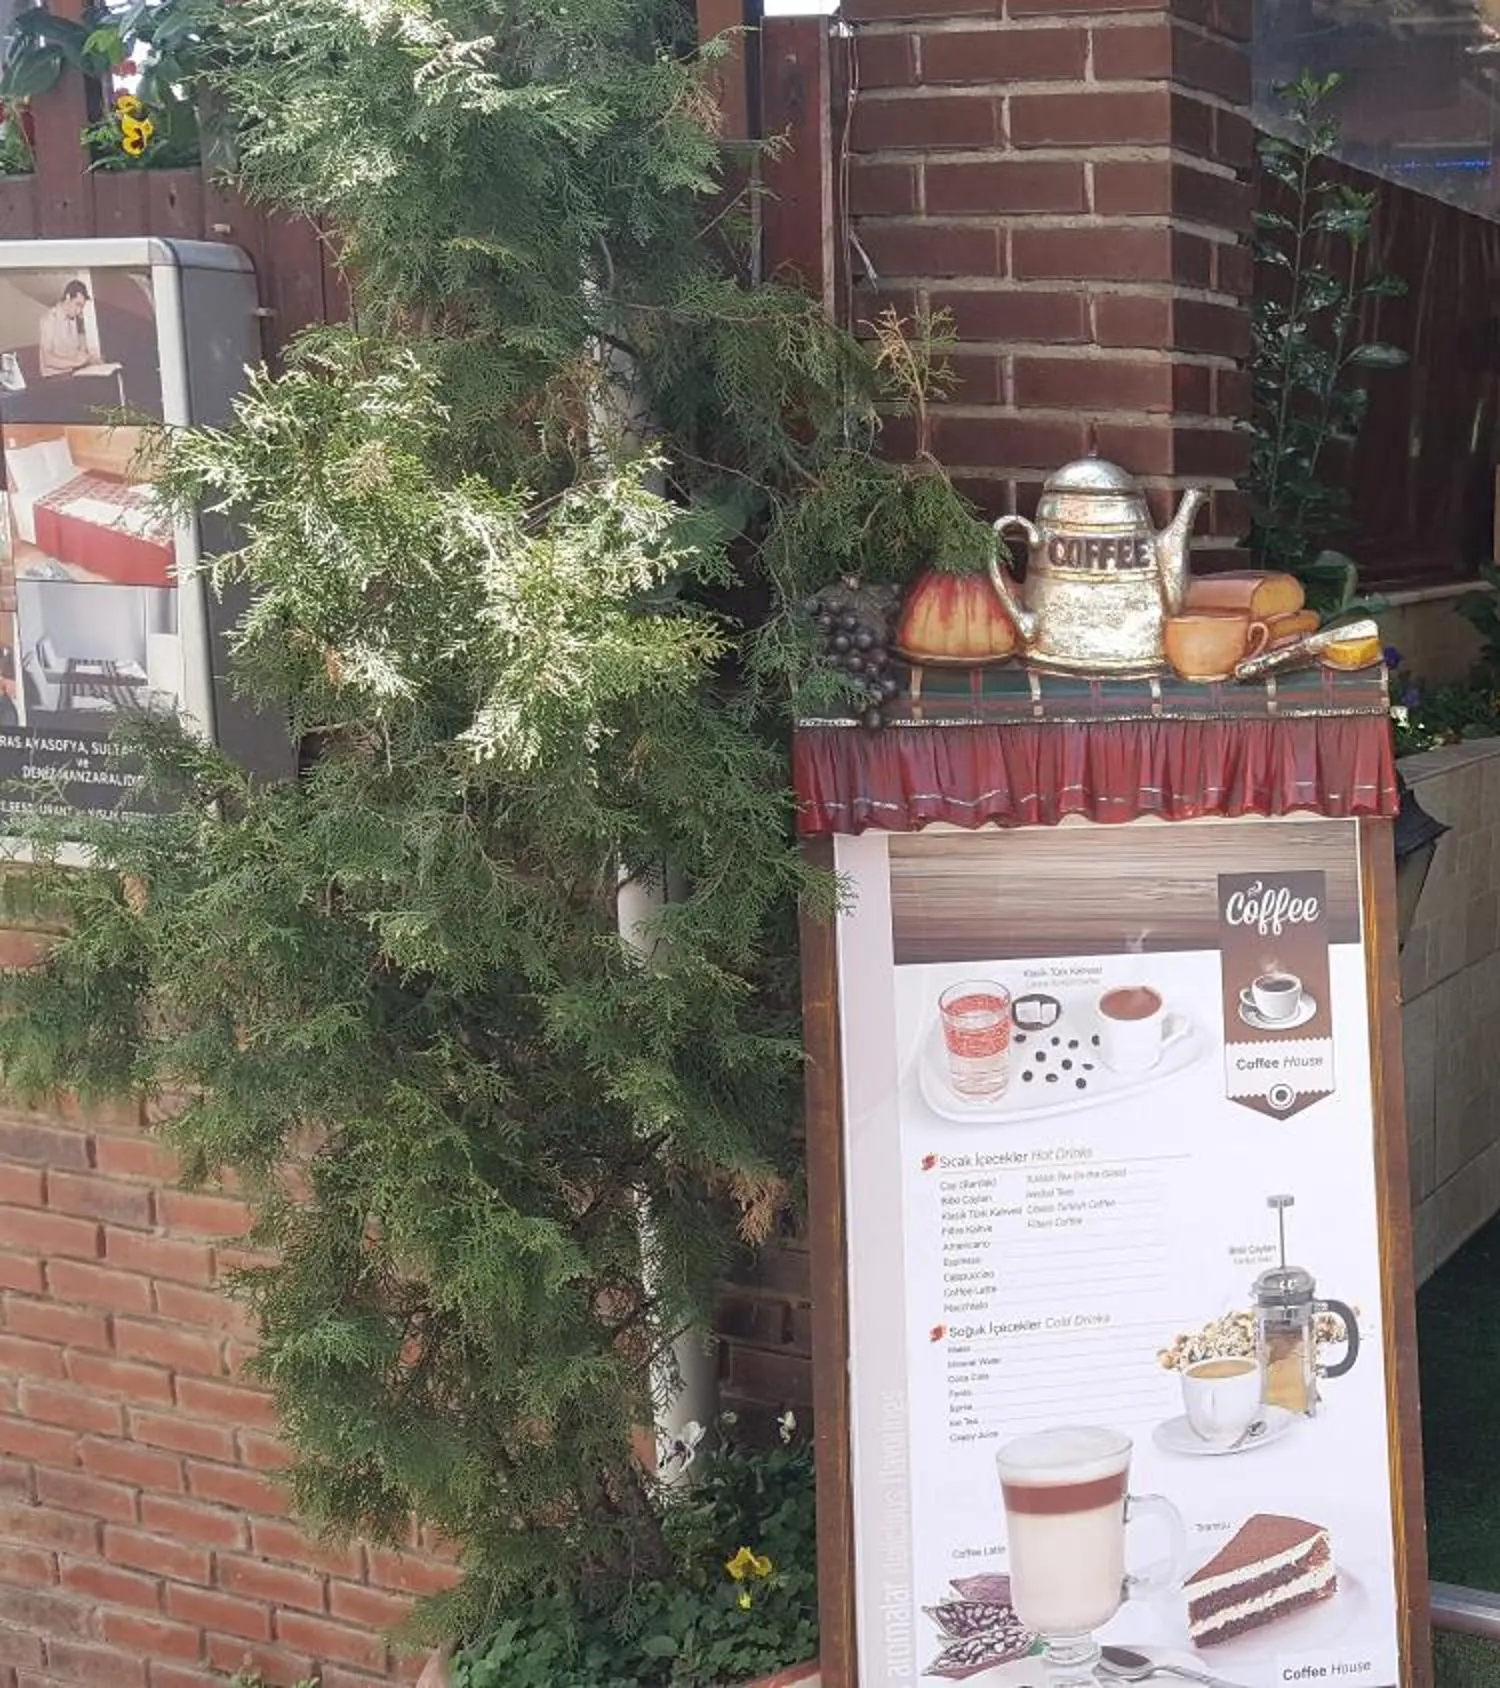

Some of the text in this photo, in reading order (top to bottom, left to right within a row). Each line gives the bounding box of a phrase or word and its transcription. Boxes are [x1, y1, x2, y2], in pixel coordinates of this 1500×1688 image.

[1048, 536, 1153, 569] COFFEE
[1226, 881, 1319, 935] Coffee
[1236, 1054, 1323, 1071] Coffee House
[1282, 1661, 1371, 1681] Coffee House
